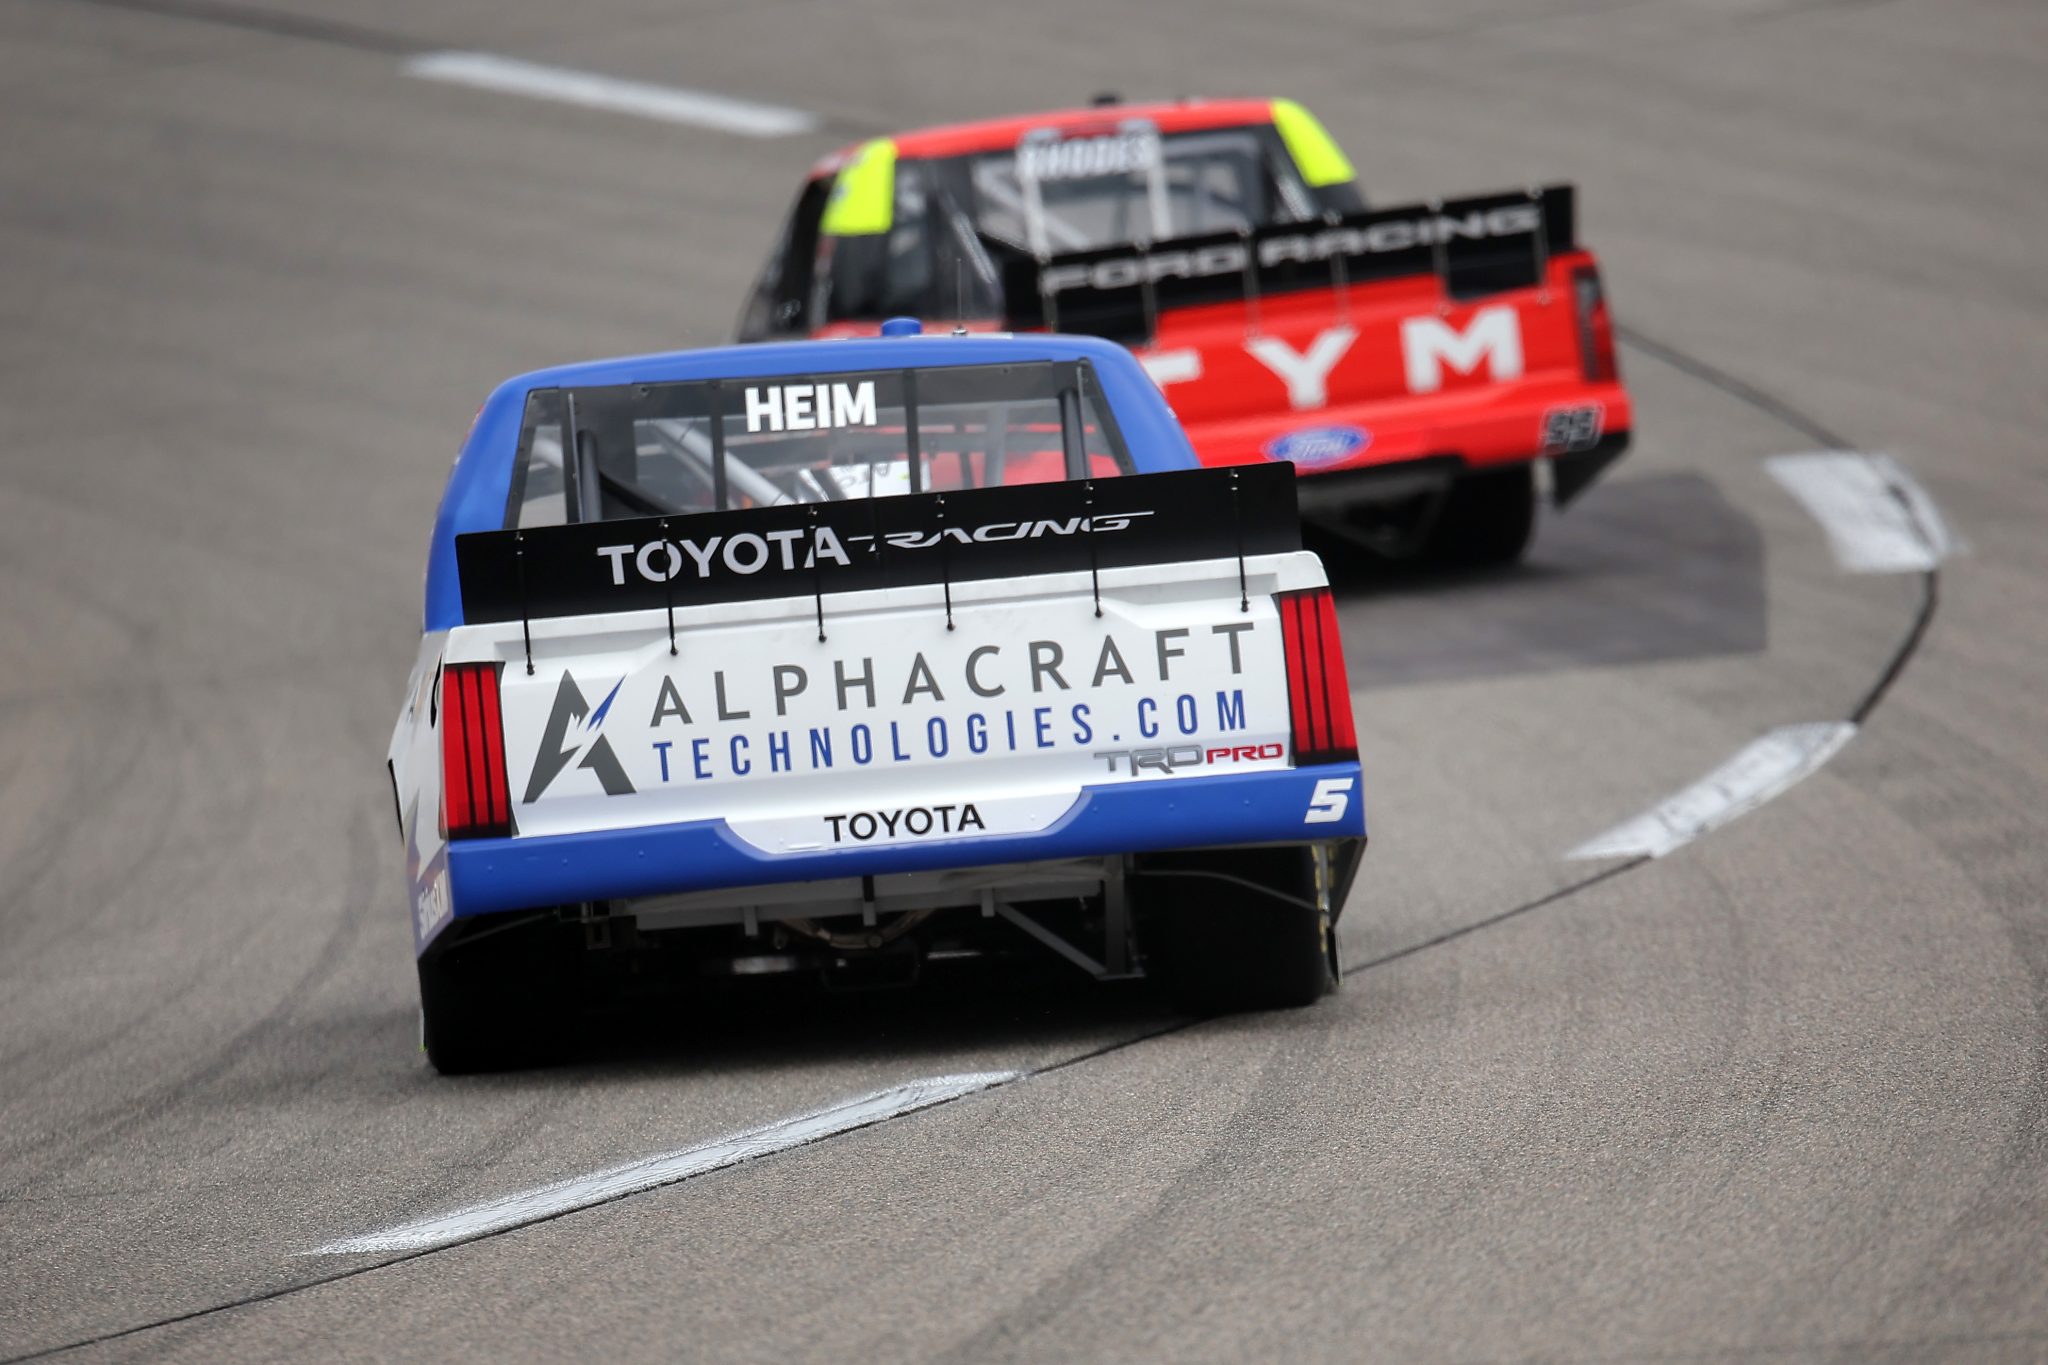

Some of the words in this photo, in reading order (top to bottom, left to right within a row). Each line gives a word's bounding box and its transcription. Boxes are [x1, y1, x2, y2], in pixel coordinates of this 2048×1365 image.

[1042, 242, 1249, 293] FORD
[1257, 203, 1540, 266] RACING
[744, 381, 877, 433] HEIM
[597, 526, 850, 586] TOYOTA
[846, 510, 1155, 553] RACING
[650, 621, 1255, 728] ALPHACRAFT
[652, 689, 1247, 782] TECHNOLOGIES.COM
[824, 803, 986, 842] TOYOTA
[1303, 777, 1354, 824] 5
